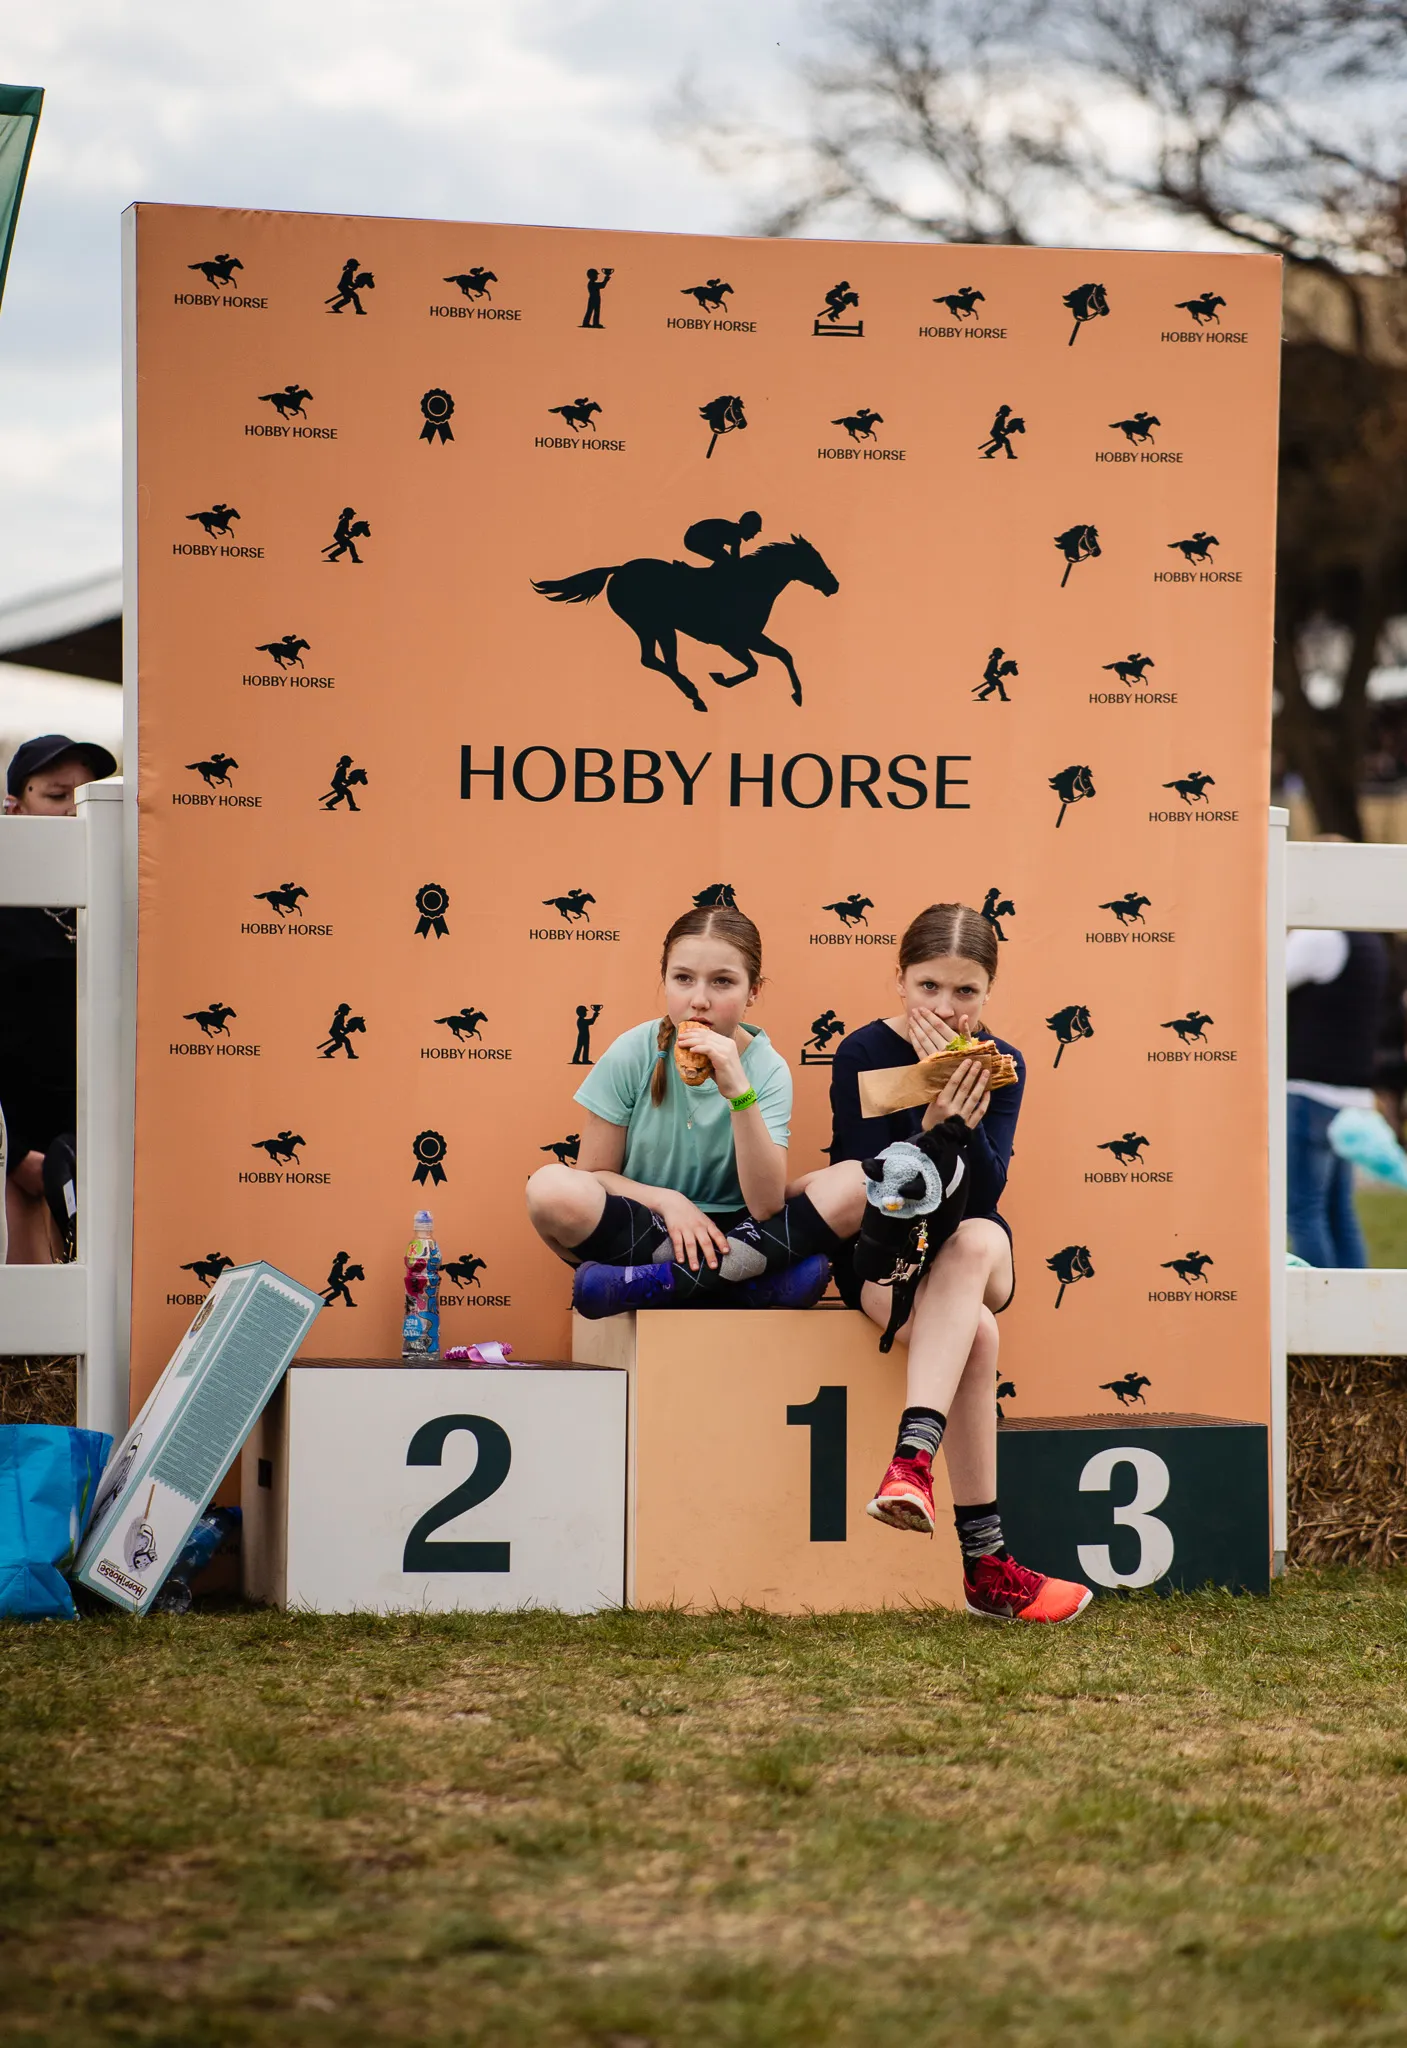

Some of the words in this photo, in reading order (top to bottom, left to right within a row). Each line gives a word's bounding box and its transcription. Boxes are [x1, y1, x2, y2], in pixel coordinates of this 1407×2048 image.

[174, 293, 221, 307] HOBBY
[222, 295, 269, 309] HORSE
[429, 305, 475, 319] HOBBY
[477, 308, 522, 321] HORSE
[667, 317, 712, 330] HOBBY
[713, 319, 757, 333] HORSE
[919, 326, 962, 338] HOBBY
[964, 327, 1007, 339] HORSE
[1161, 331, 1204, 343] HOBBY
[1206, 332, 1248, 344] HORSE
[244, 424, 291, 438] HOBBY
[292, 426, 338, 440] HORSE
[534, 436, 580, 449] HOBBY
[581, 439, 626, 452] HORSE
[817, 448, 862, 460] HOBBY
[863, 449, 906, 461] HORSE
[1095, 451, 1137, 463] HOBBY
[1140, 452, 1183, 464] HORSE
[172, 543, 219, 557] HOBBY
[220, 545, 265, 559] HORSE
[1154, 571, 1196, 583] HOBBY
[1199, 571, 1242, 583] HORSE
[242, 674, 288, 687] HOBBY
[290, 676, 335, 689] HORSE
[1089, 693, 1131, 704] HOBBY
[1134, 693, 1178, 704] HORSE
[460, 744, 712, 806] HOBBY
[730, 752, 972, 810] HORSE
[172, 793, 217, 806] HOBBY
[218, 795, 263, 808] HORSE
[1149, 811, 1193, 822] HOBBY
[1195, 810, 1239, 822] HORSE
[241, 922, 287, 935] HOBBY
[288, 924, 333, 936] HORSE
[529, 928, 574, 941] HOBBY
[576, 929, 621, 942] HORSE
[809, 933, 853, 945] HOBBY
[855, 934, 897, 945] HORSE
[1085, 932, 1130, 943] HOBBY
[1131, 932, 1175, 943] HORSE
[169, 1043, 215, 1056] HOBBY
[216, 1044, 261, 1057] HORSE
[420, 1047, 466, 1060] HOBBY
[468, 1048, 512, 1060] HORSE
[1147, 1051, 1190, 1062] HOBBY
[1194, 1050, 1237, 1062] HORSE
[238, 1171, 284, 1184] HOBBY
[285, 1172, 331, 1184] HORSE
[1084, 1172, 1127, 1183] HOBBY
[1130, 1171, 1173, 1183] HORSE
[439, 1295, 465, 1307] BBY
[466, 1295, 511, 1307] HORSE
[1148, 1291, 1193, 1302] HOBBY
[1194, 1290, 1237, 1302] HORSE
[786, 1385, 848, 1542] 1
[403, 1413, 512, 1573] 2
[1076, 1446, 1174, 1589] 3
